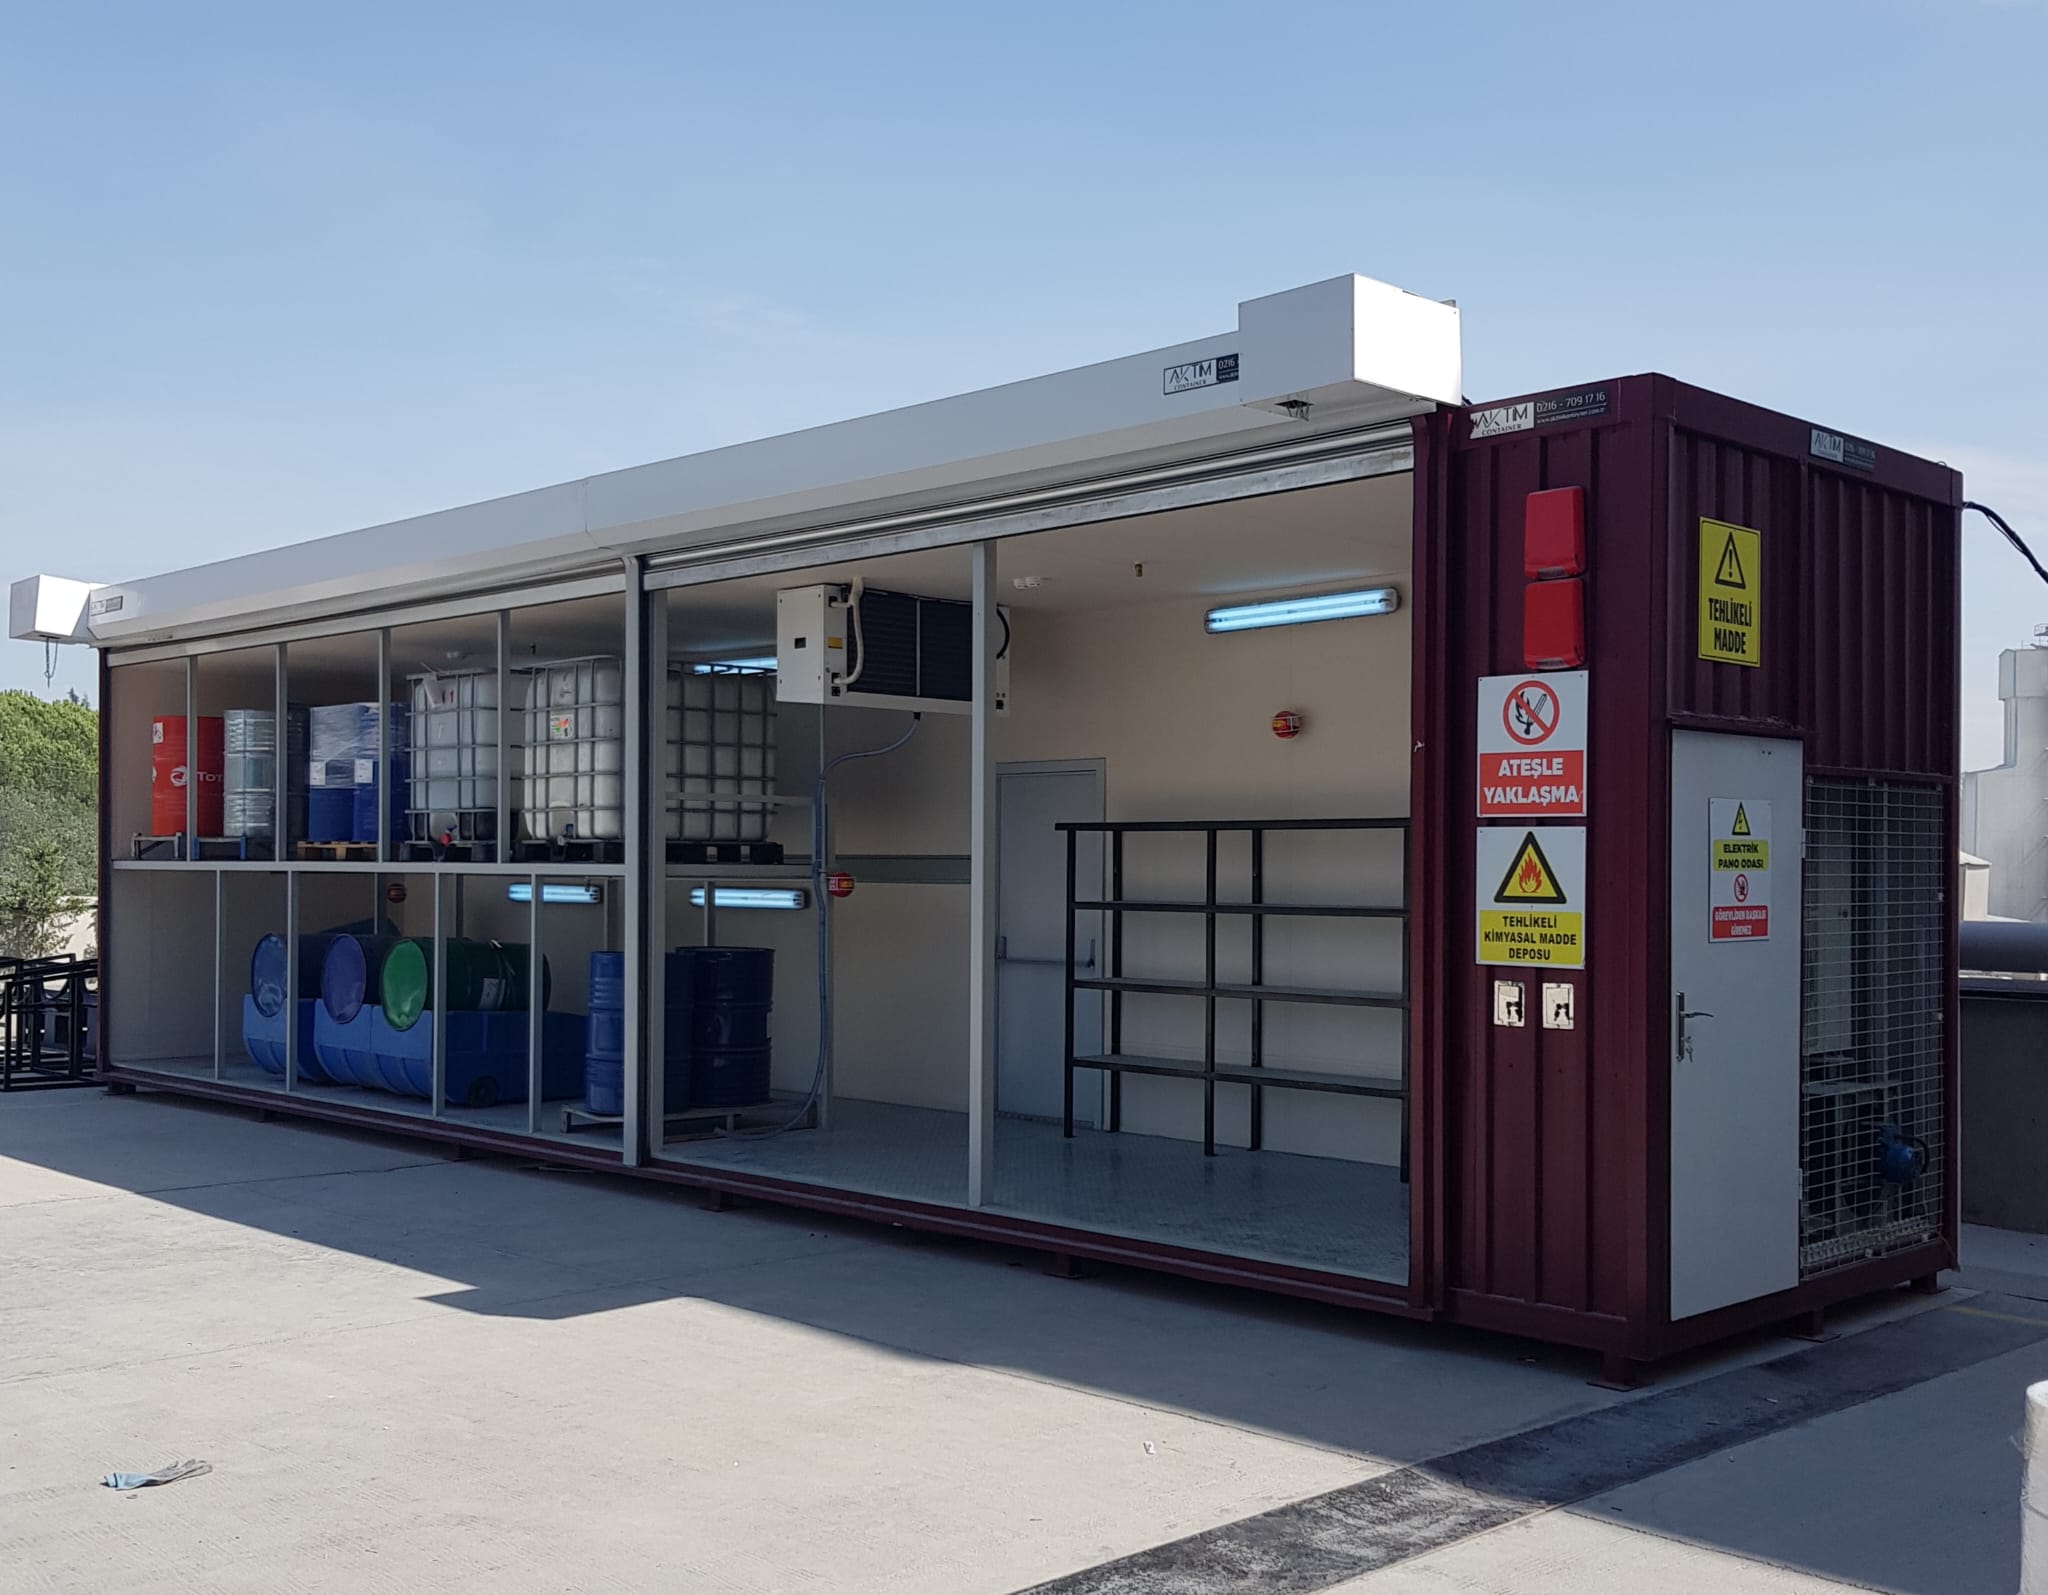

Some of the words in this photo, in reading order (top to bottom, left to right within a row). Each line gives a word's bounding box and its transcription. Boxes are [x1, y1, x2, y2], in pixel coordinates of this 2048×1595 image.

[1536, 400, 1557, 413] 0216
[1565, 396, 1583, 408] 709
[1585, 393, 1594, 404] 17
[1596, 391, 1606, 402] 16
[1481, 423, 1522, 436] CONTAINER
[1708, 597, 1752, 627] TEHLİKELİ
[1714, 627, 1746, 654] MADDE
[1498, 757, 1564, 779] ATEŞLE
[197, 771, 224, 782] TOT
[1483, 786, 1579, 806] YAKLAŞMA
[1723, 842, 1760, 854] ELEKTRİK
[1718, 859, 1739, 869] PANO
[1502, 913, 1557, 929] TEHLİKELİ
[1484, 929, 1537, 944] KİMYASAL
[1539, 932, 1577, 946] MADDE
[1508, 947, 1551, 961] DEPOSU
